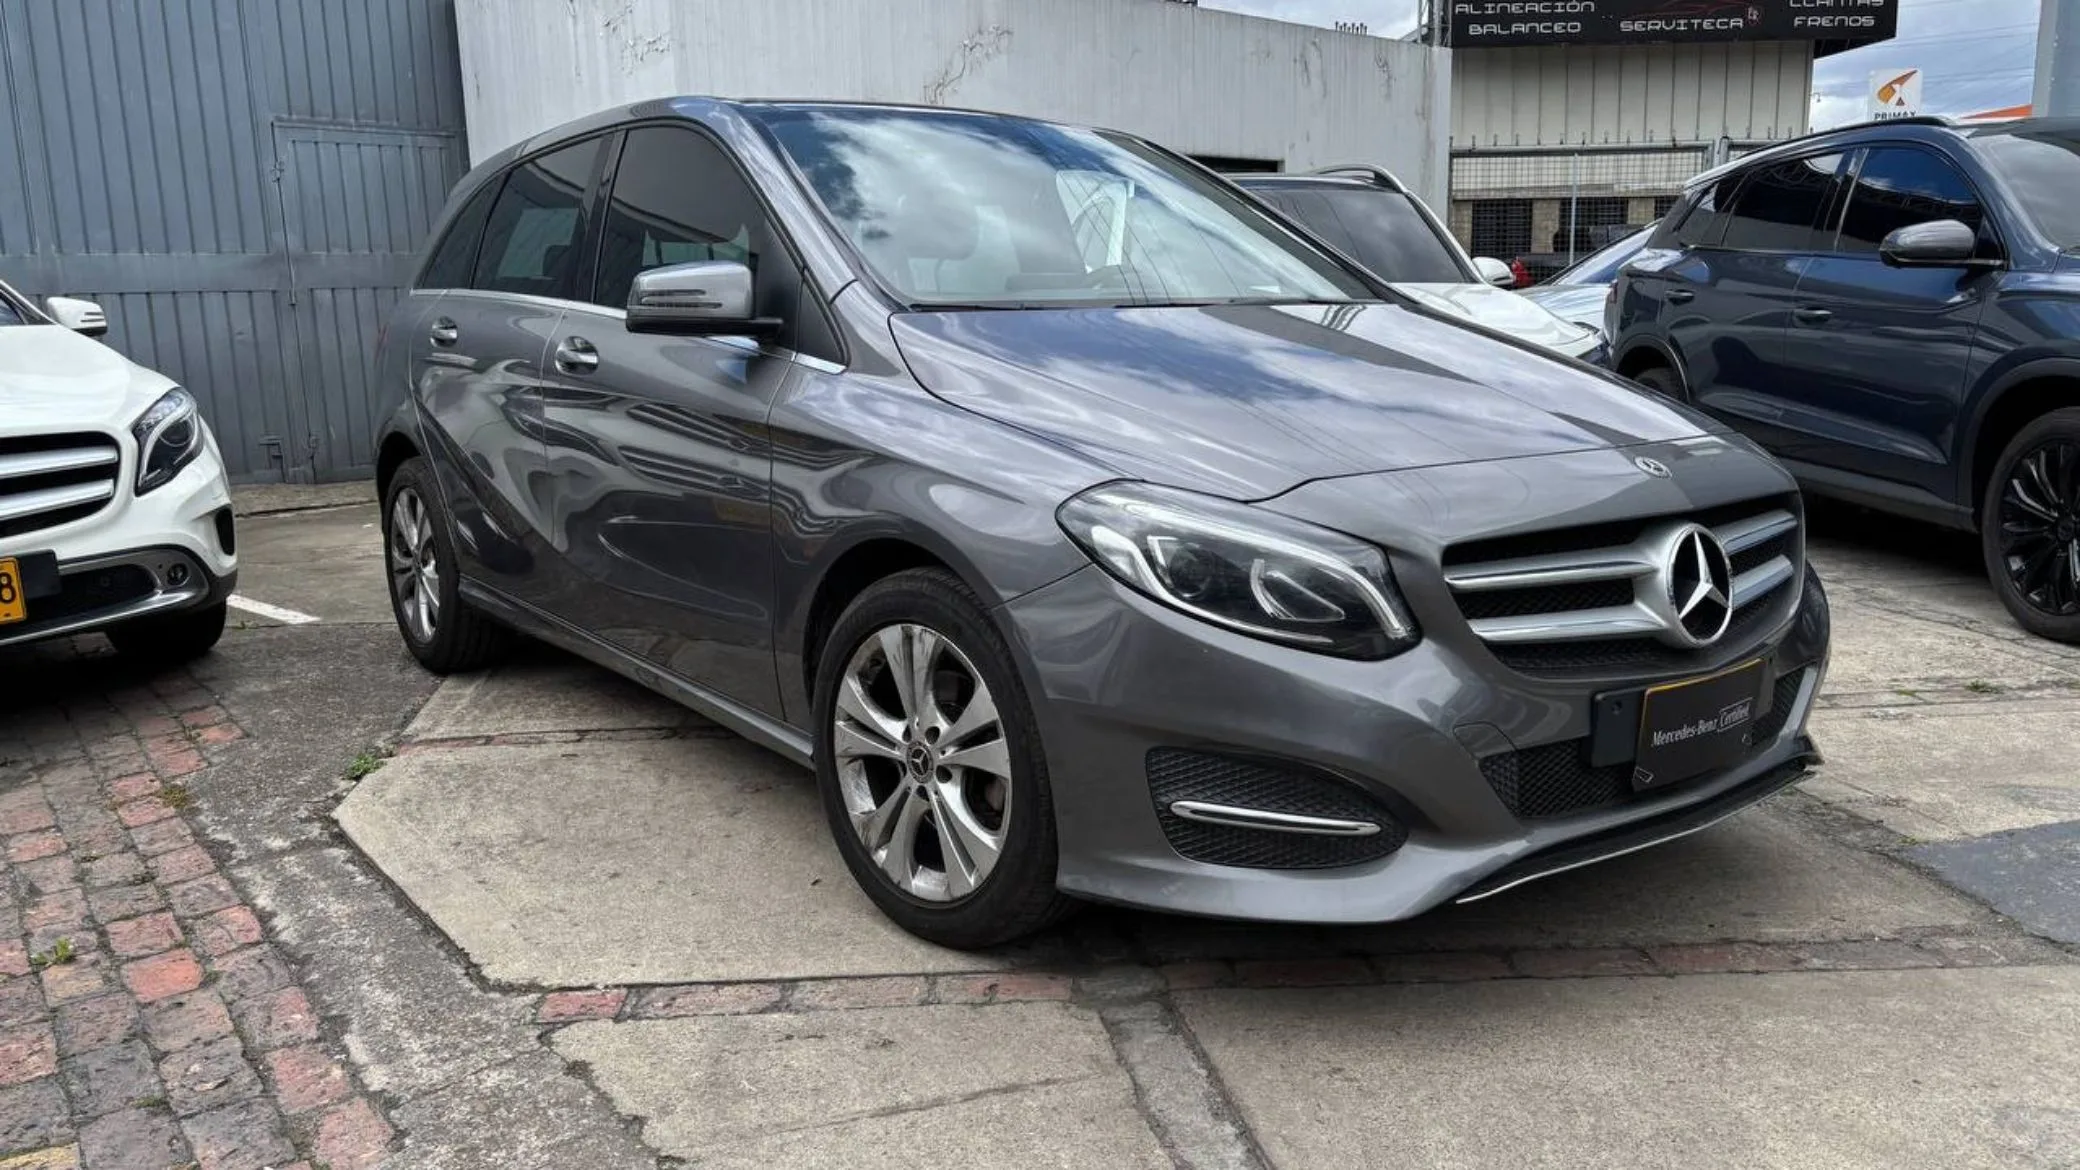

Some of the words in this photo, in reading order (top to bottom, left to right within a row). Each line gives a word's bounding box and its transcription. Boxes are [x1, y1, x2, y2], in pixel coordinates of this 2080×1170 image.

[1455, 0, 1595, 14] ALINEACIÓN
[1619, 17, 1744, 32] SERVITECA
[1793, 15, 1876, 27] FRENOS
[1468, 22, 1582, 36] BALANCEO
[1874, 110, 1917, 120] PRIMAX
[1651, 719, 1719, 747] Mercedes-Benz
[1719, 700, 1751, 728] Certified
